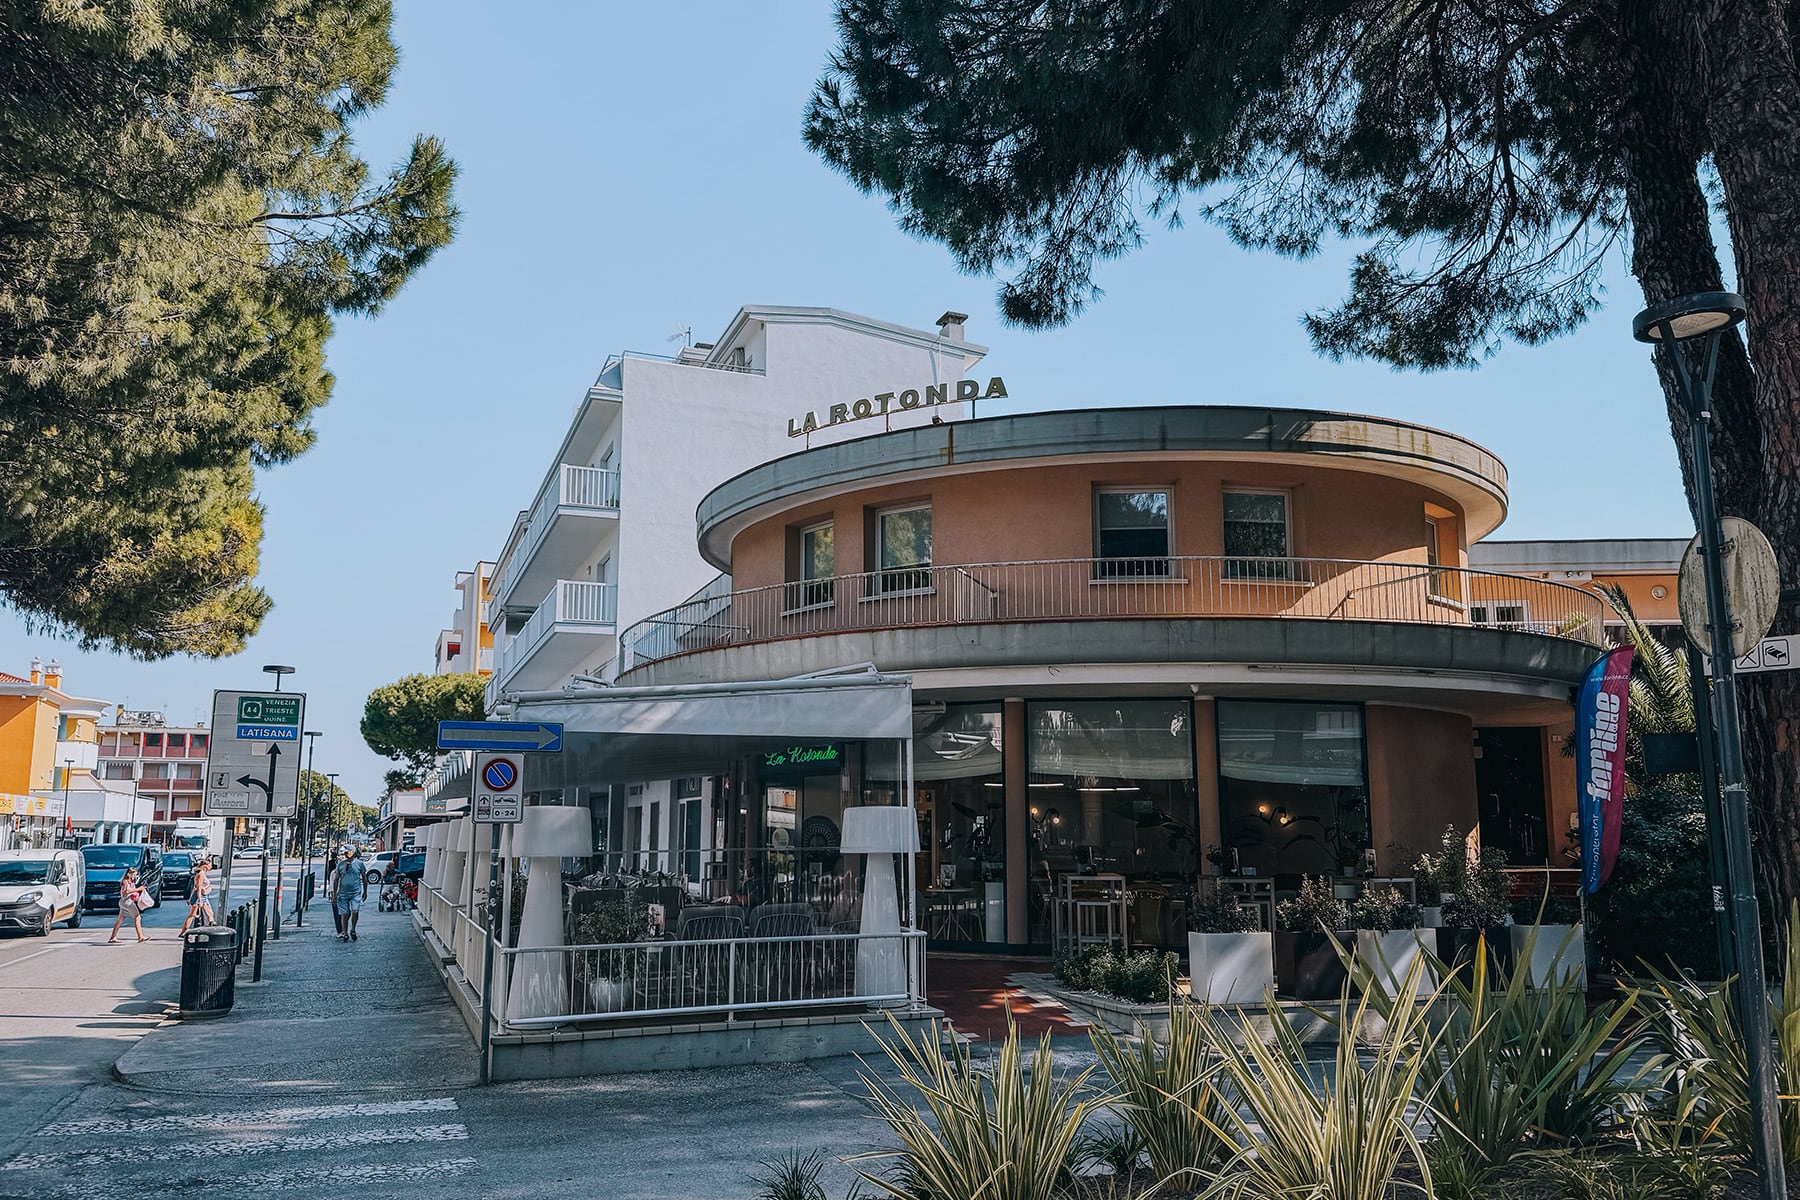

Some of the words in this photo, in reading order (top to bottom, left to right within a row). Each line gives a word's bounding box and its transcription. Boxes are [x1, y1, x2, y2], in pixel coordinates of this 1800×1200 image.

[788, 411, 819, 437] LA
[829, 376, 1009, 424] ROTONDA
[241, 728, 293, 738] LATISANA
[764, 752, 786, 766] La
